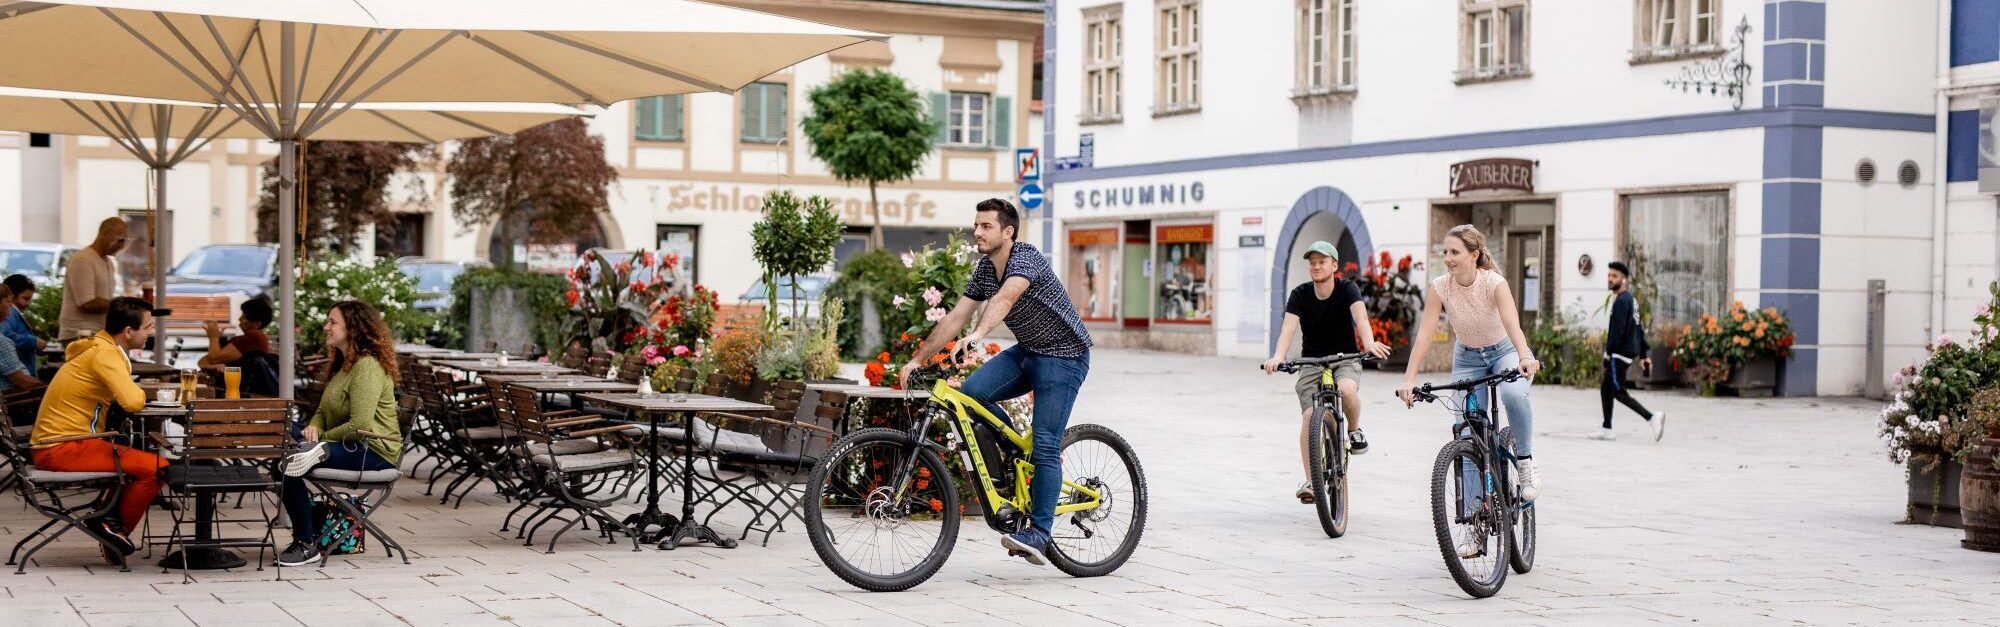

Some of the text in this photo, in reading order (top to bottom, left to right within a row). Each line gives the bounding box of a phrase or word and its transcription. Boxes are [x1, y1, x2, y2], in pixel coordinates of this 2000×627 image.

[1451, 164, 1531, 191] ZAUBERER
[1074, 181, 1204, 208] SCHUMNIG
[825, 442, 854, 470] MAXXIS
[960, 419, 993, 491] FOCUS
